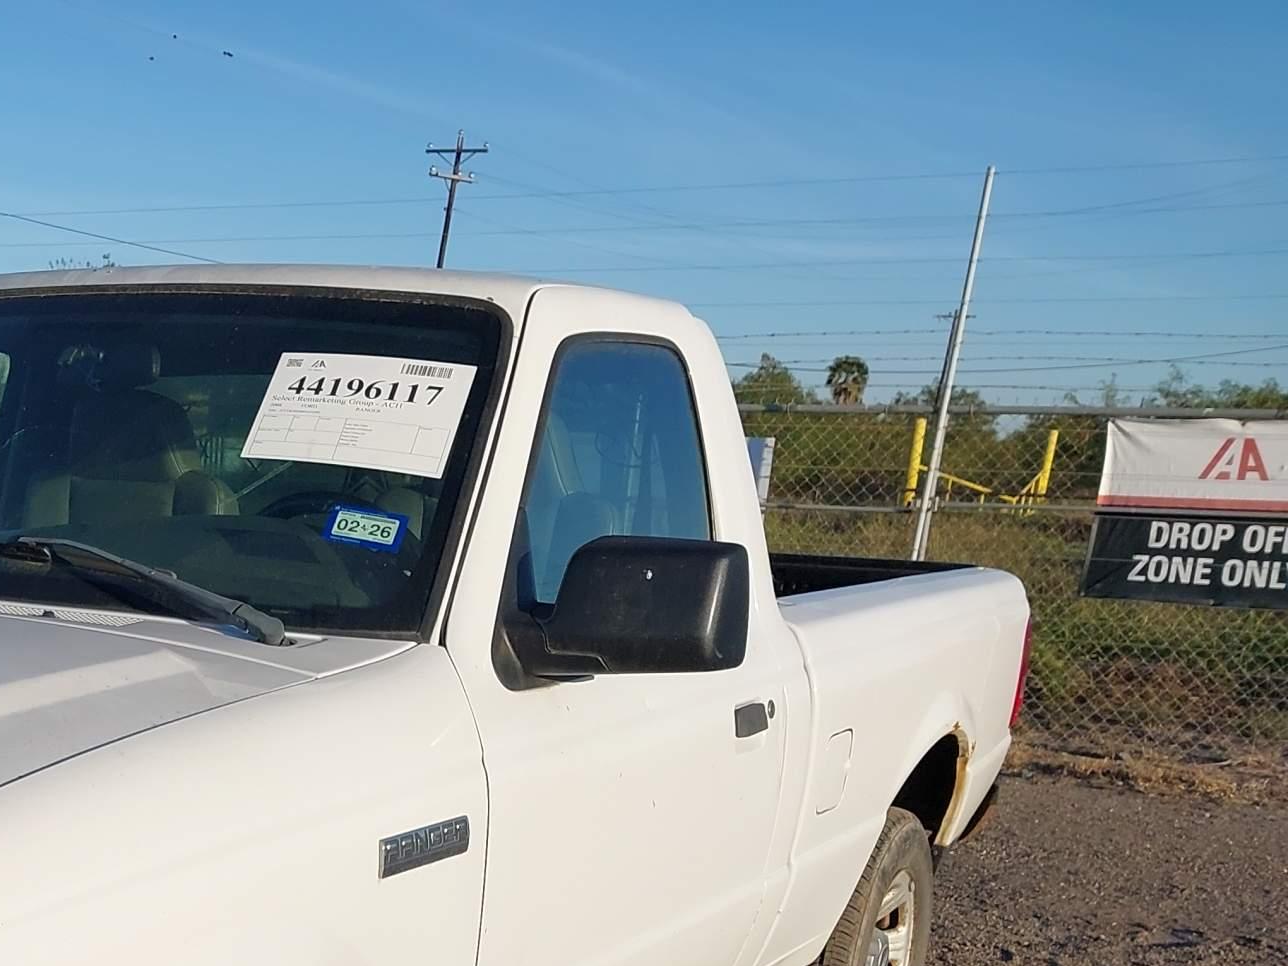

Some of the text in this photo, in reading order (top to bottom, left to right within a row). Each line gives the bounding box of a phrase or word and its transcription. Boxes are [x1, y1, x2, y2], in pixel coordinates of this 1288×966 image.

[288, 376, 445, 406] 44196117
[297, 396, 347, 406] Remarketing
[349, 399, 374, 408] Group
[1147, 520, 1236, 551] DROP
[1127, 554, 1288, 590] ZONE ONL
